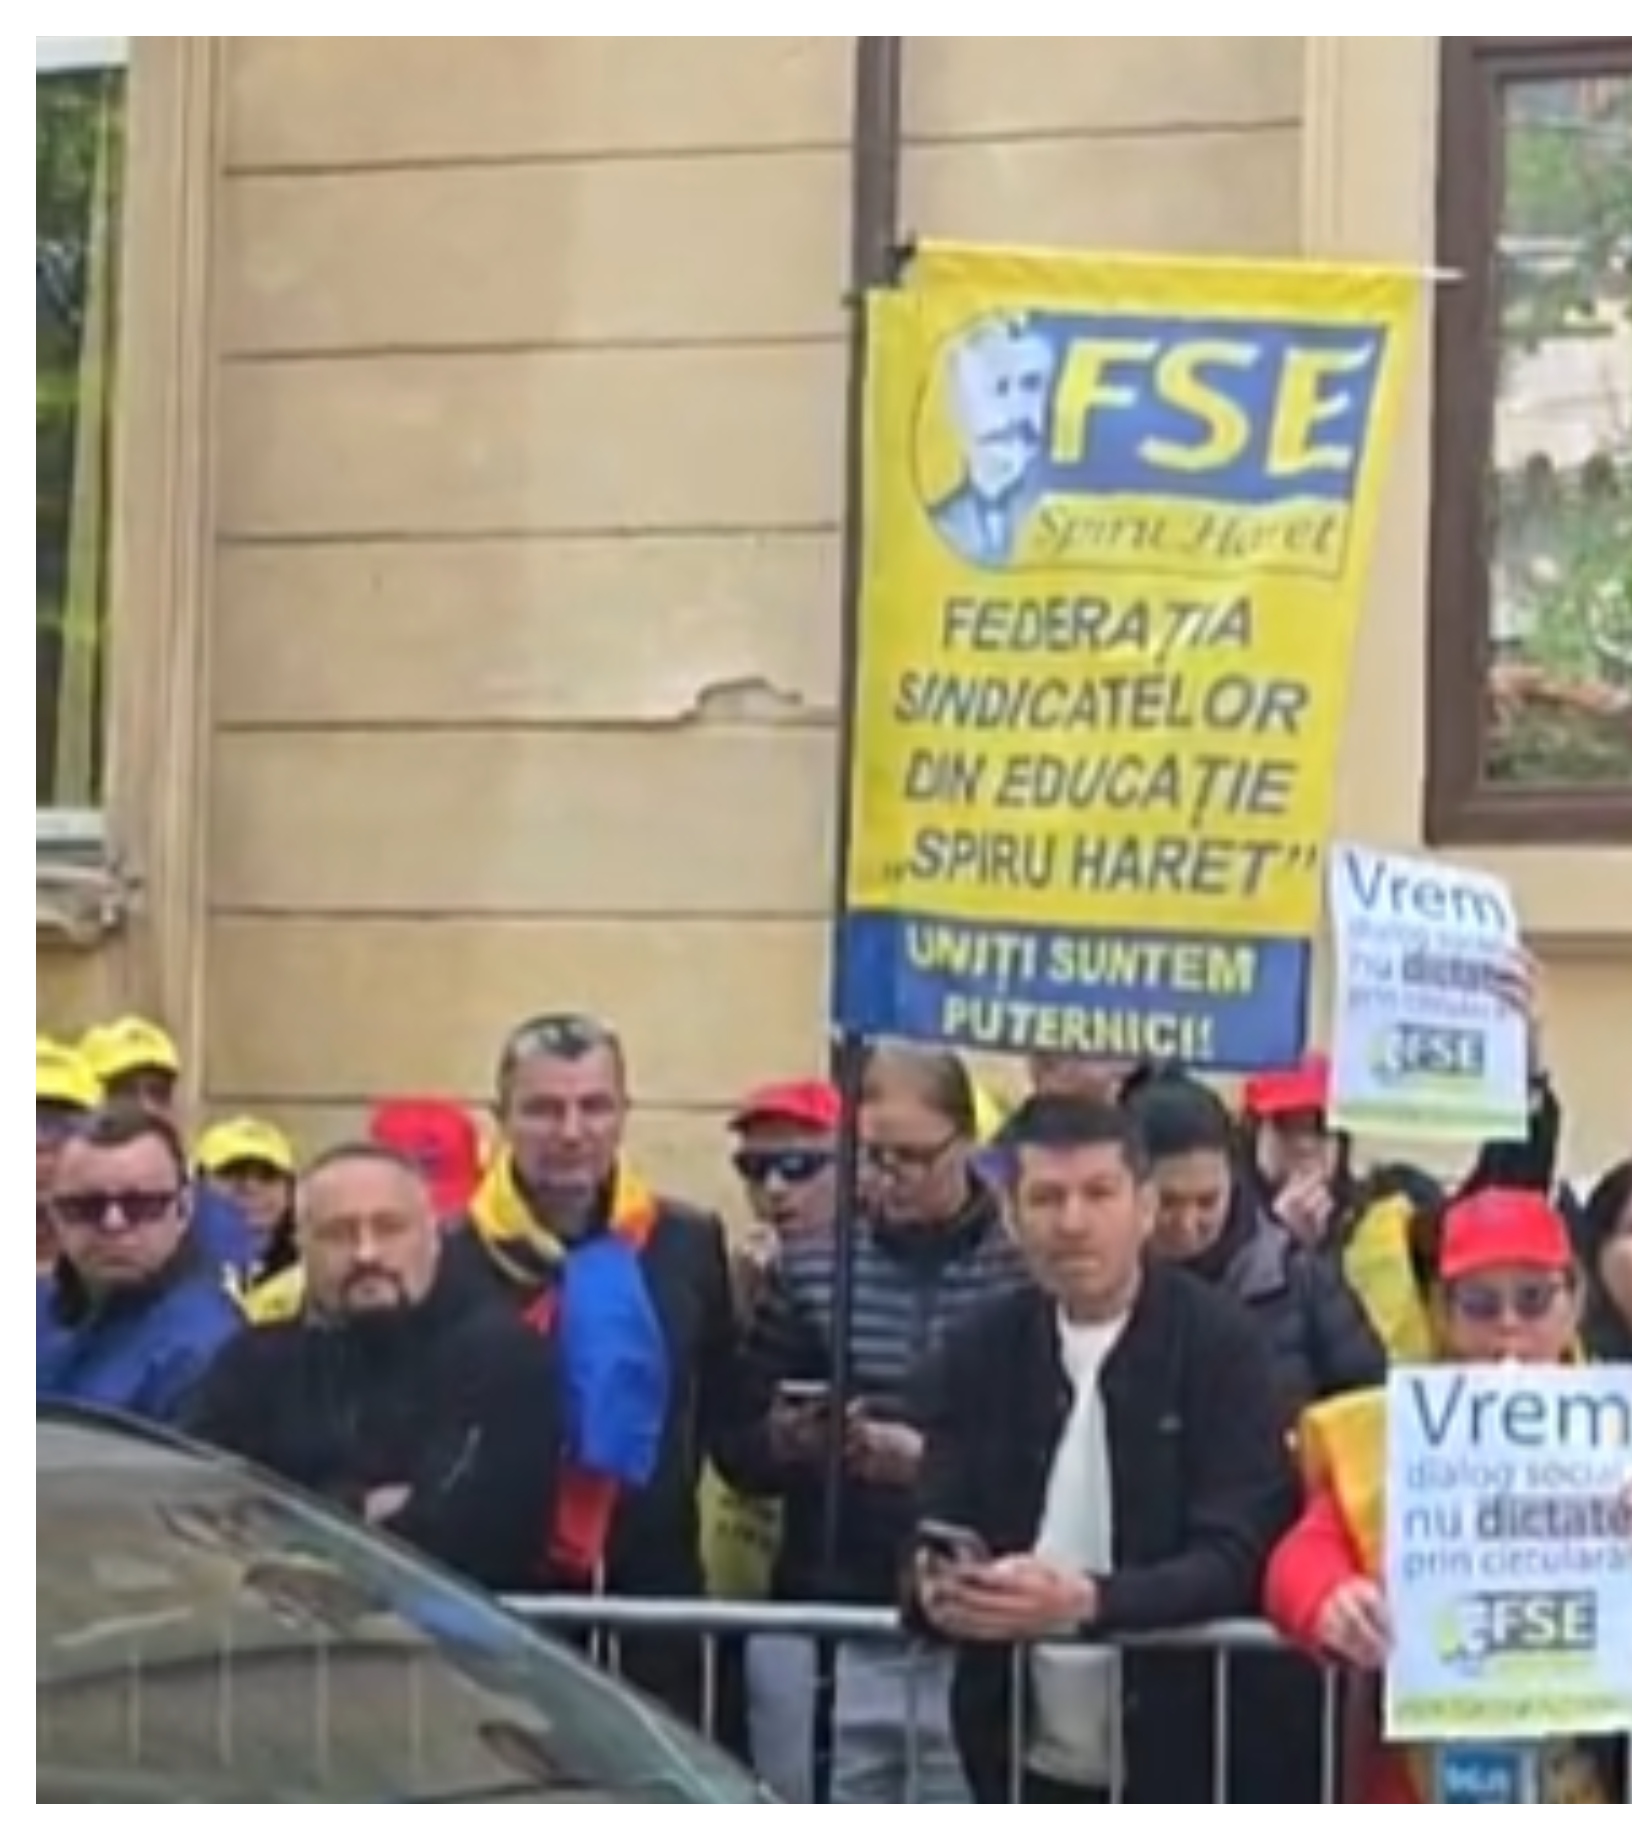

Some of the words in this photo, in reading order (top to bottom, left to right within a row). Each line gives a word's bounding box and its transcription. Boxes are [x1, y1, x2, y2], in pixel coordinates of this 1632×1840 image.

[1050, 336, 1376, 477] FSE
[1036, 501, 1168, 557] Spiru
[941, 595, 1253, 666] FEDERAȚIA
[894, 669, 1312, 736] SINDICATELOR
[904, 747, 988, 804] DIN
[1002, 752, 1300, 829] EDUCAȚIE
[1345, 850, 1509, 931] Vrem
[1047, 933, 1258, 997] SUNTEM
[1410, 1374, 1632, 1449] Vrem
[1406, 1455, 1516, 1494] dialog
[1402, 1502, 1465, 1540] nu
[1402, 1546, 1472, 1583] prin
[1492, 1598, 1594, 1643] FSE
